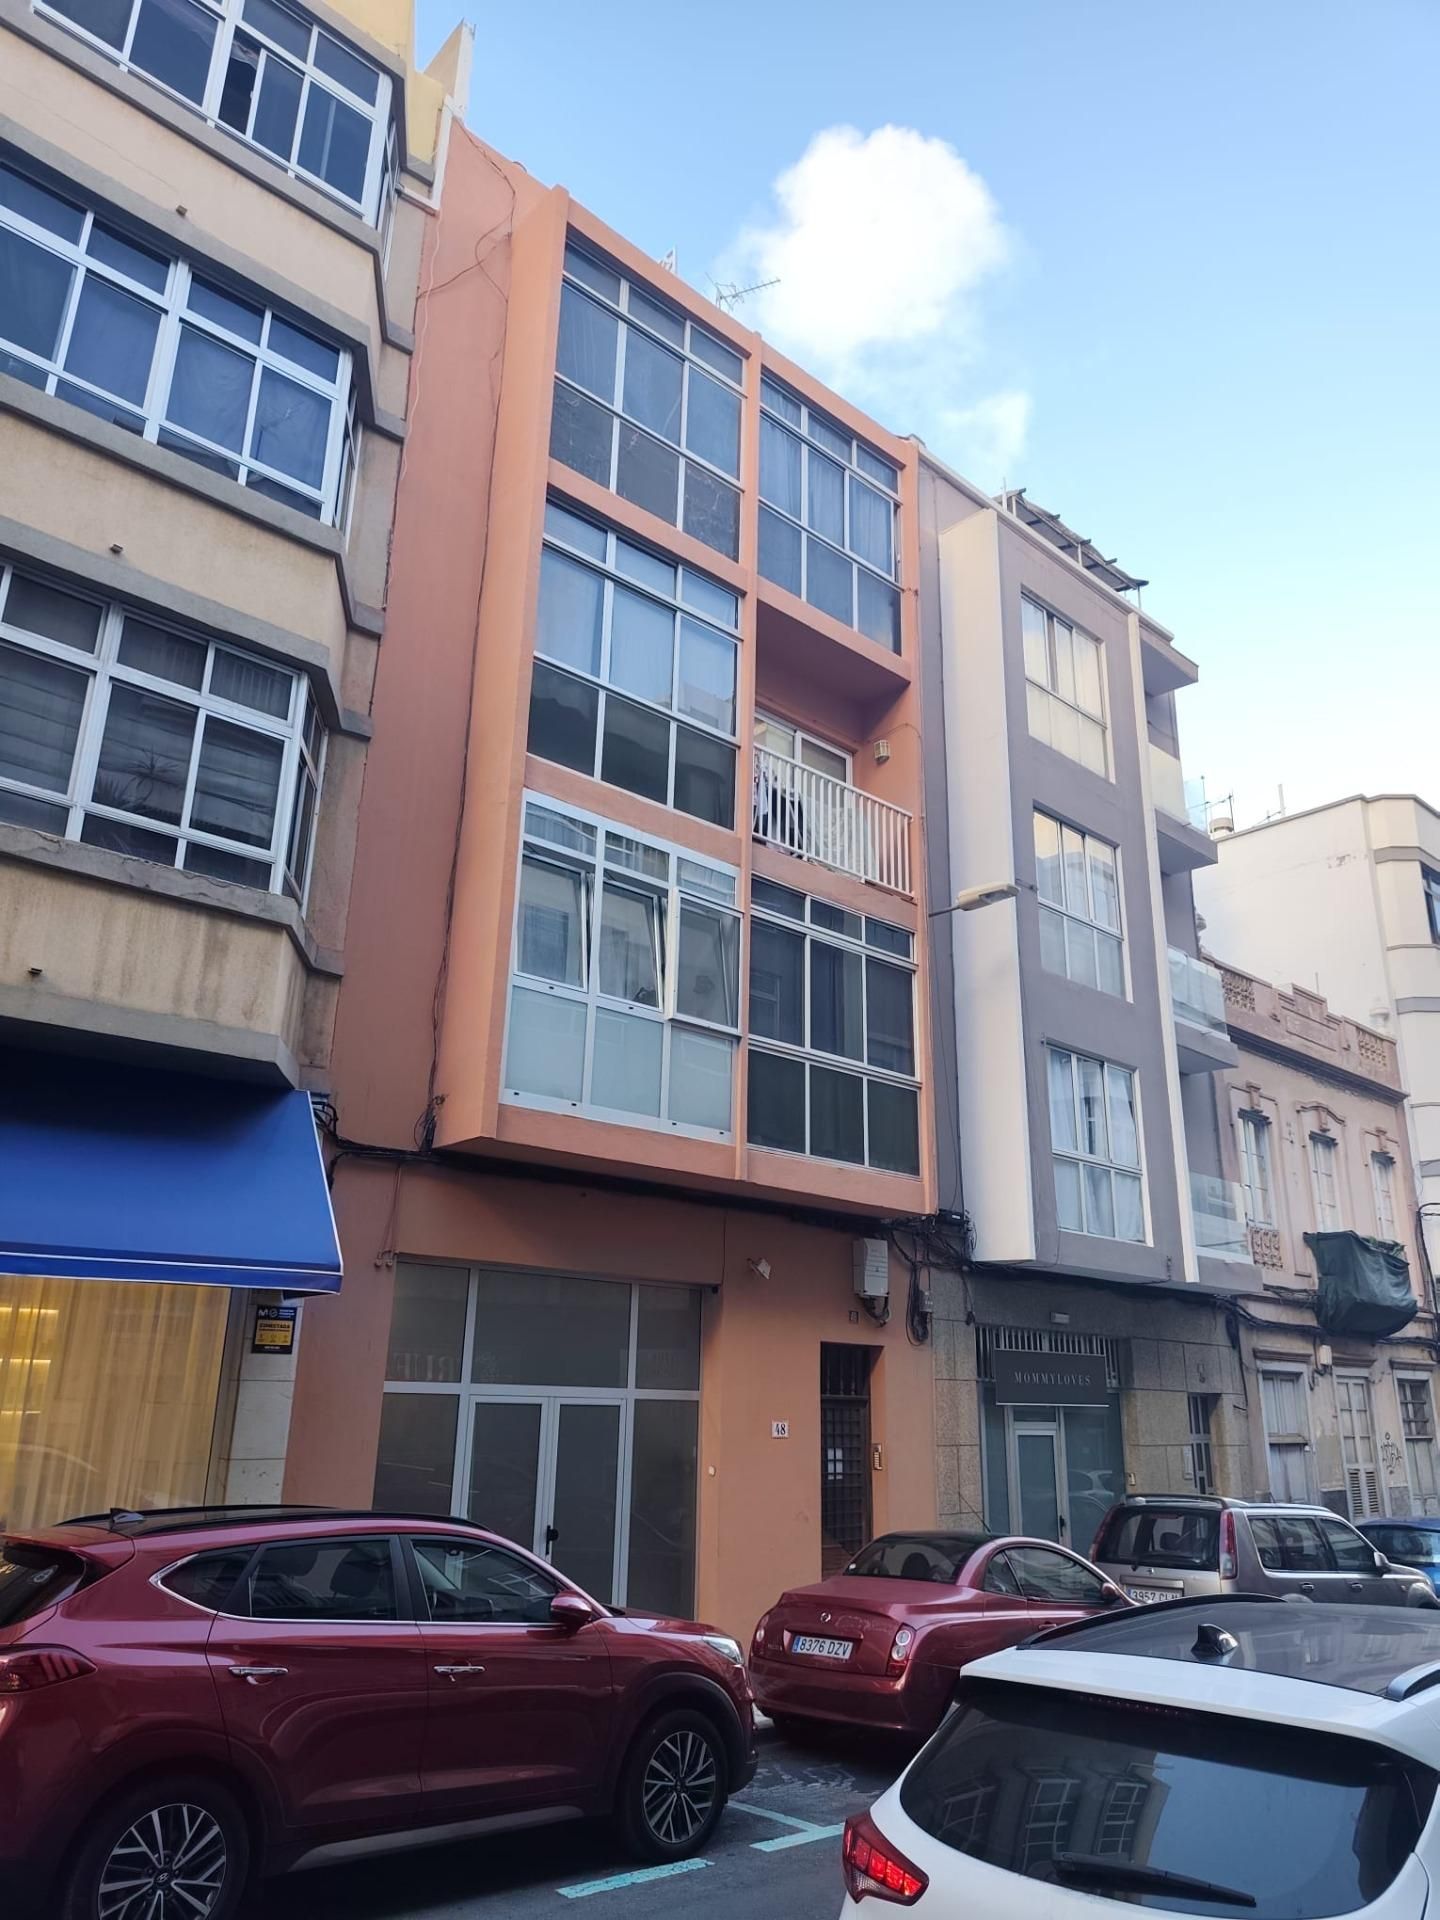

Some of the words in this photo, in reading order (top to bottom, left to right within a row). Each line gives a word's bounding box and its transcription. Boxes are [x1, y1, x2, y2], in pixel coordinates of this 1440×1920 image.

[1014, 1371, 1092, 1386] MOMMYLOVES
[774, 1423, 786, 1436] 48
[1131, 1590, 1156, 1601] 3957
[799, 1638, 826, 1654] 8376
[827, 1641, 850, 1657] DZV
